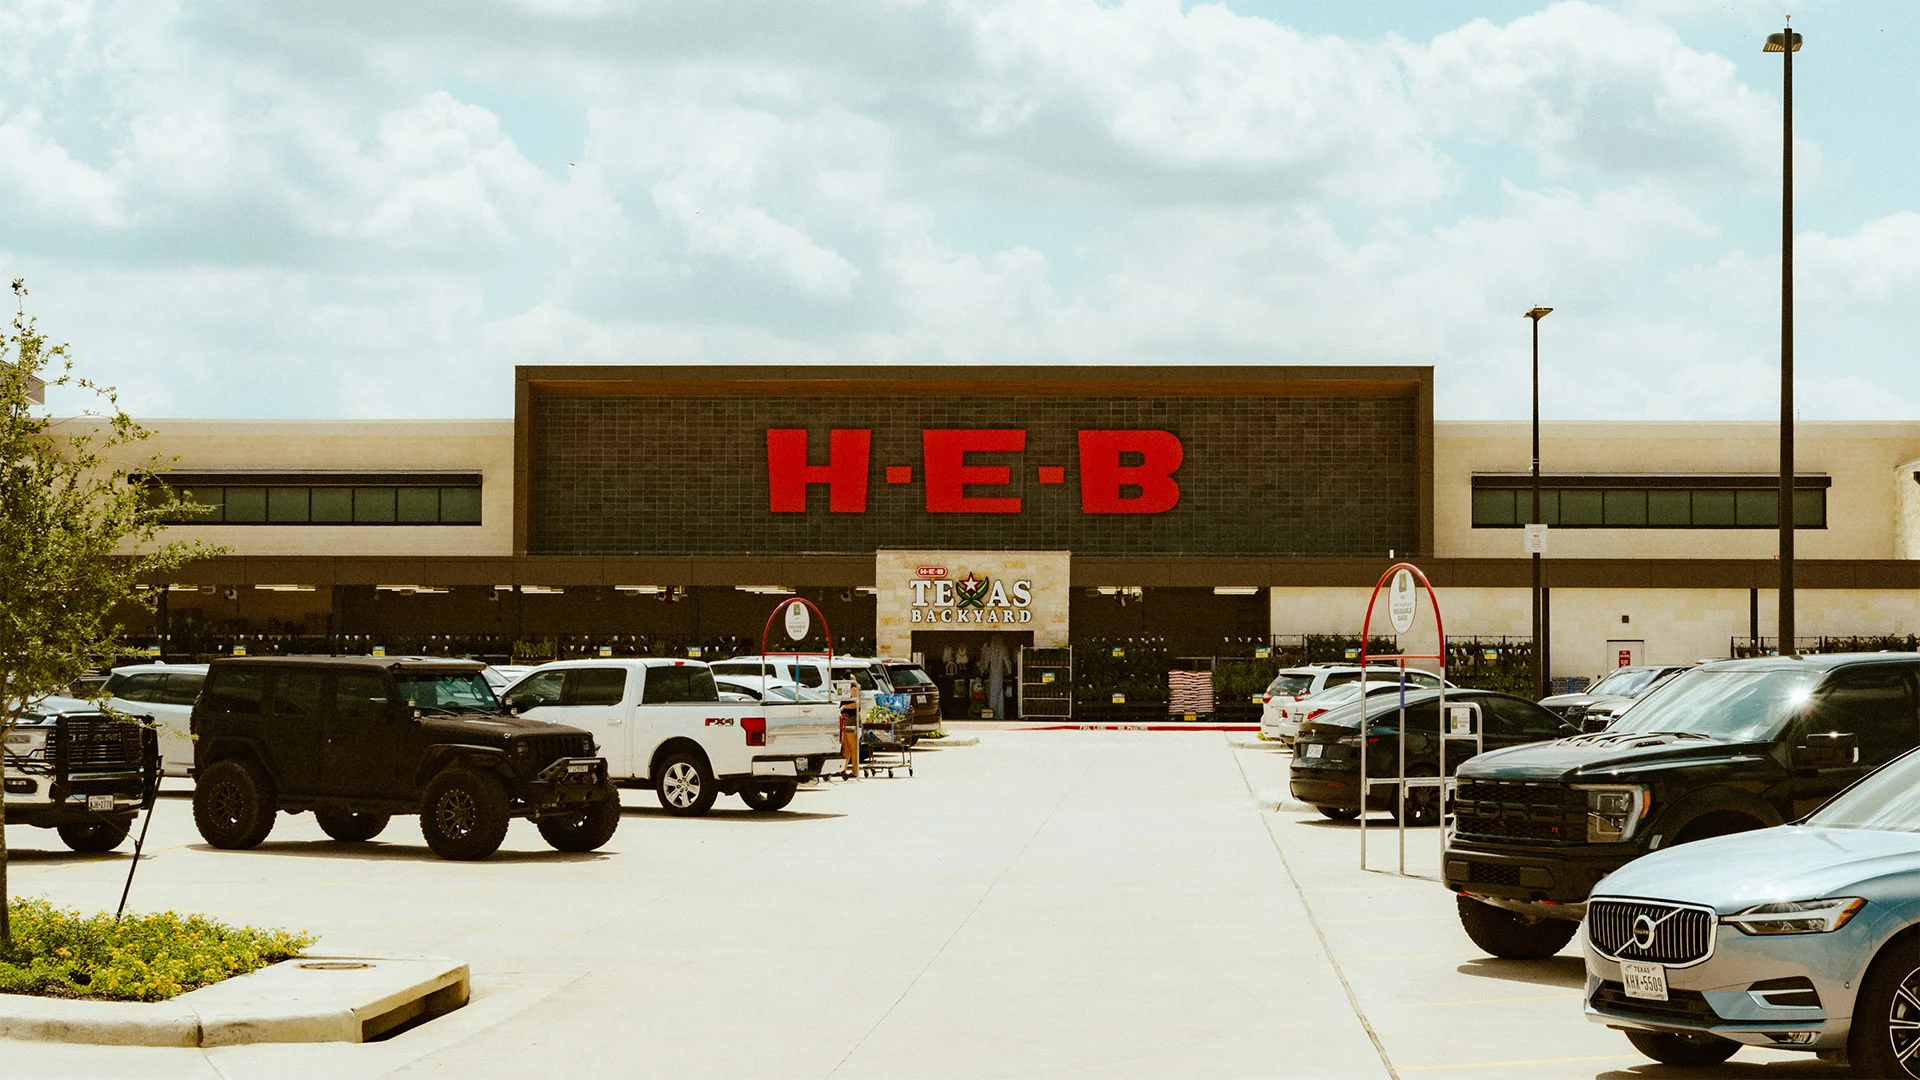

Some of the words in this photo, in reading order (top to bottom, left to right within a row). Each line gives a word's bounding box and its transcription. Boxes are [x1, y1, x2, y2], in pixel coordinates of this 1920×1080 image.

[909, 576, 1032, 608] TEXAS
[910, 609, 1033, 623] BACKYARD
[705, 718, 734, 726] FX4
